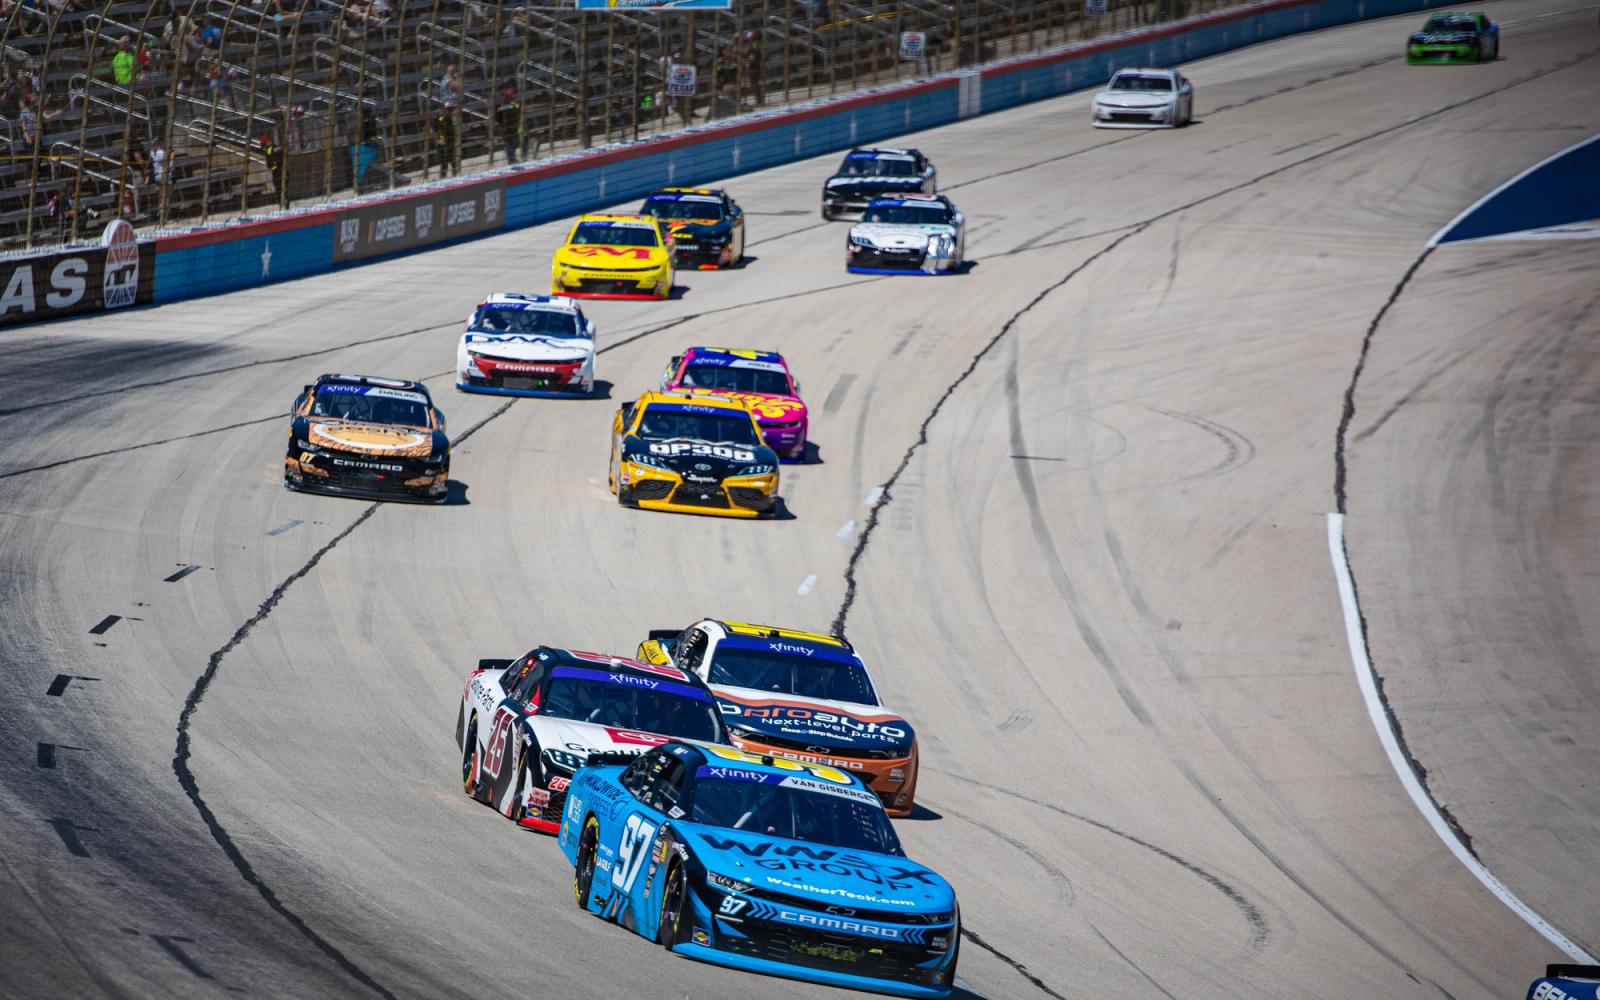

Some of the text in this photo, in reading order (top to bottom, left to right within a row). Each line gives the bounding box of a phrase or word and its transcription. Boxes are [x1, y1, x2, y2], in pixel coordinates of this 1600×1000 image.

[326, 385, 361, 393] xfinity
[333, 458, 403, 472] CAMARO
[768, 642, 815, 657] xfinity
[608, 673, 659, 689] xfinity
[761, 718, 900, 745] Next-level parts.
[549, 776, 570, 791] 26
[709, 768, 768, 783] xfinity
[791, 778, 872, 801] VAN GISBERGE
[612, 815, 656, 893] 97
[755, 858, 914, 891] GROUP
[766, 876, 916, 907] WeatherTech.com
[719, 897, 747, 915] 97
[780, 911, 899, 938] CAMARO
